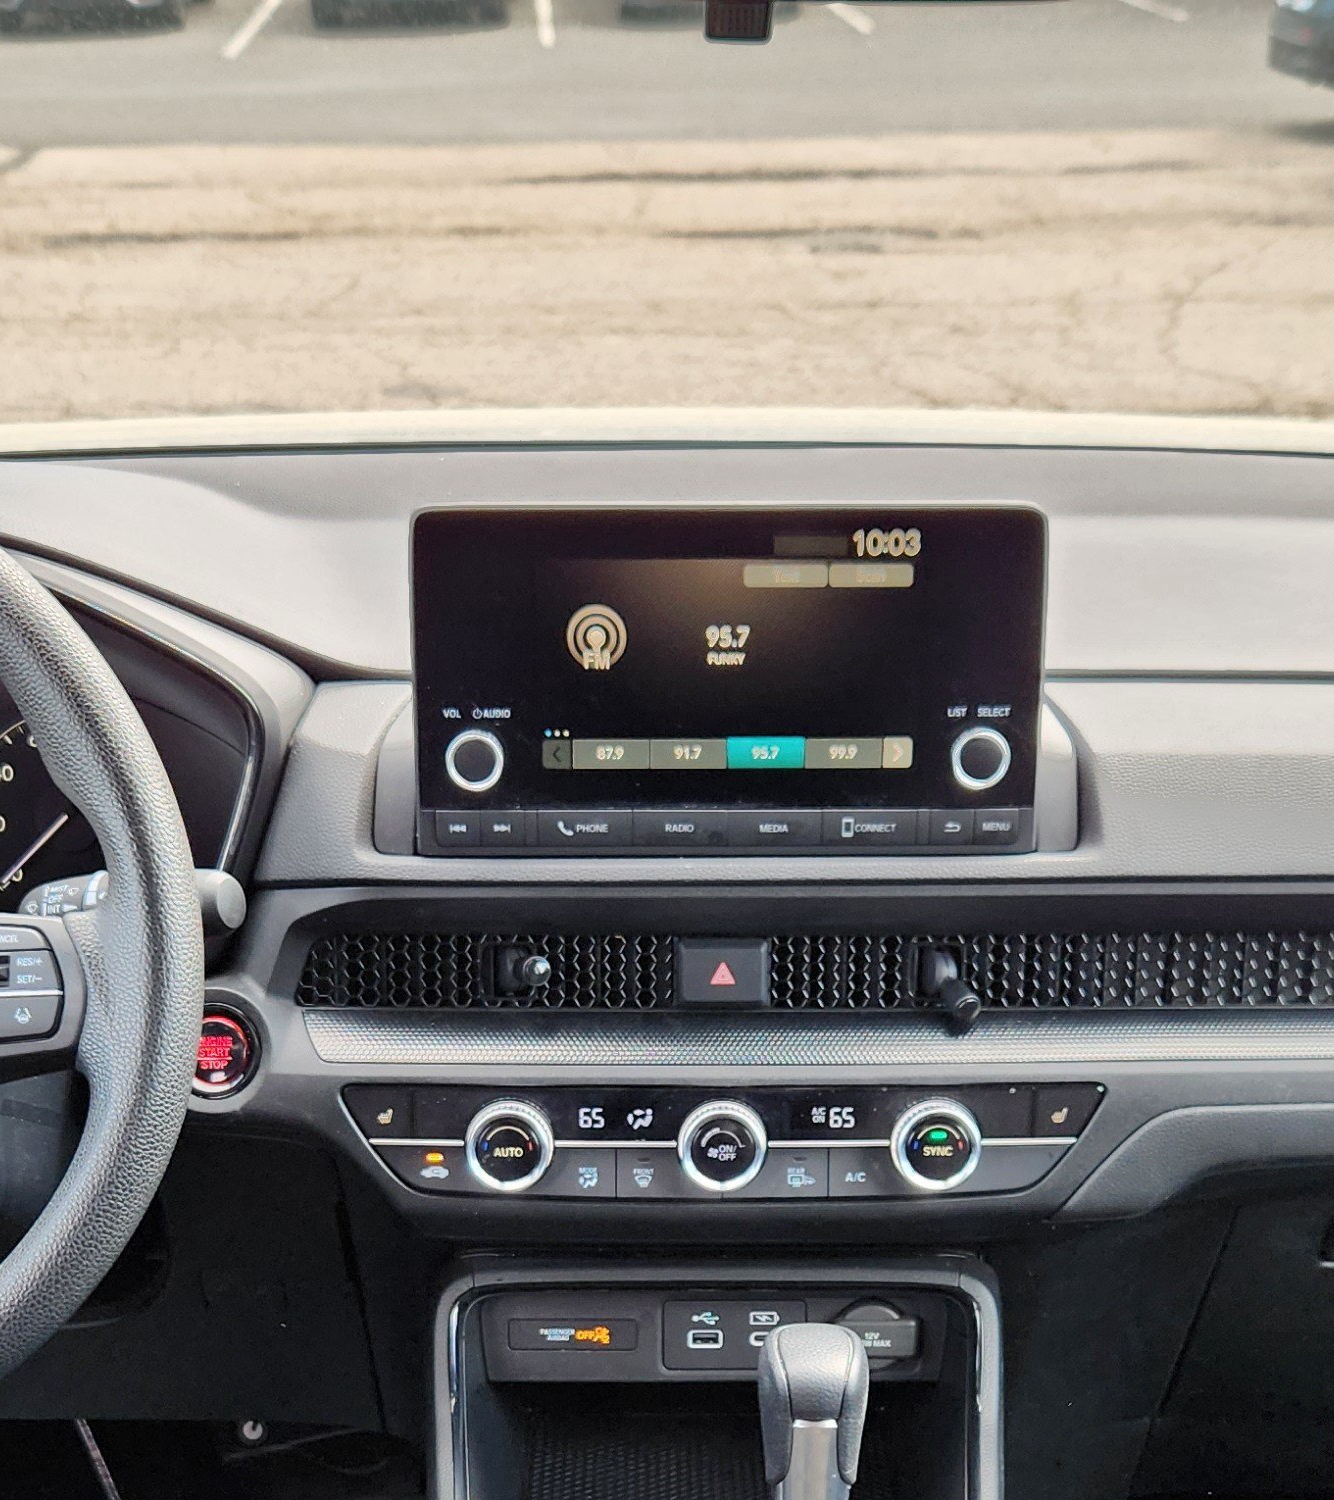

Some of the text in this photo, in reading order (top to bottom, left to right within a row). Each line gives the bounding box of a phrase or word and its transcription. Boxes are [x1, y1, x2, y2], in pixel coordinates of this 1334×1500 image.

[852, 526, 922, 558] 10:03
[705, 624, 751, 648] 95.7
[582, 650, 611, 670] FM
[706, 651, 747, 666] FUNKY
[442, 708, 462, 719] VOL
[483, 707, 511, 719] AUDIO
[947, 705, 1011, 717] LIST SELECT
[596, 744, 624, 761] 87.9
[674, 744, 702, 761] 91.7
[751, 744, 780, 761] 95.7
[828, 744, 858, 761] 99.9
[576, 823, 609, 833] PHONE
[664, 823, 695, 834] RADIO
[759, 823, 789, 834] MEDIA
[854, 822, 897, 833] CONNECT
[982, 822, 1011, 832] MENU
[48, 904, 60, 914] INT
[199, 1047, 231, 1057] START
[199, 1060, 229, 1070] STOP
[578, 1107, 605, 1129] 65
[812, 1115, 826, 1123] ON
[829, 1107, 856, 1129] 65
[493, 1146, 524, 1158] AUTO
[718, 1144, 737, 1154] ON/
[922, 1146, 953, 1158] SYNC
[718, 1153, 737, 1162] OFF
[633, 1167, 655, 1175] FRONT
[845, 1172, 867, 1183] A/C
[575, 1329, 595, 1341] OFF
[864, 1331, 881, 1340] 12V
[873, 1339, 892, 1348] MAX
